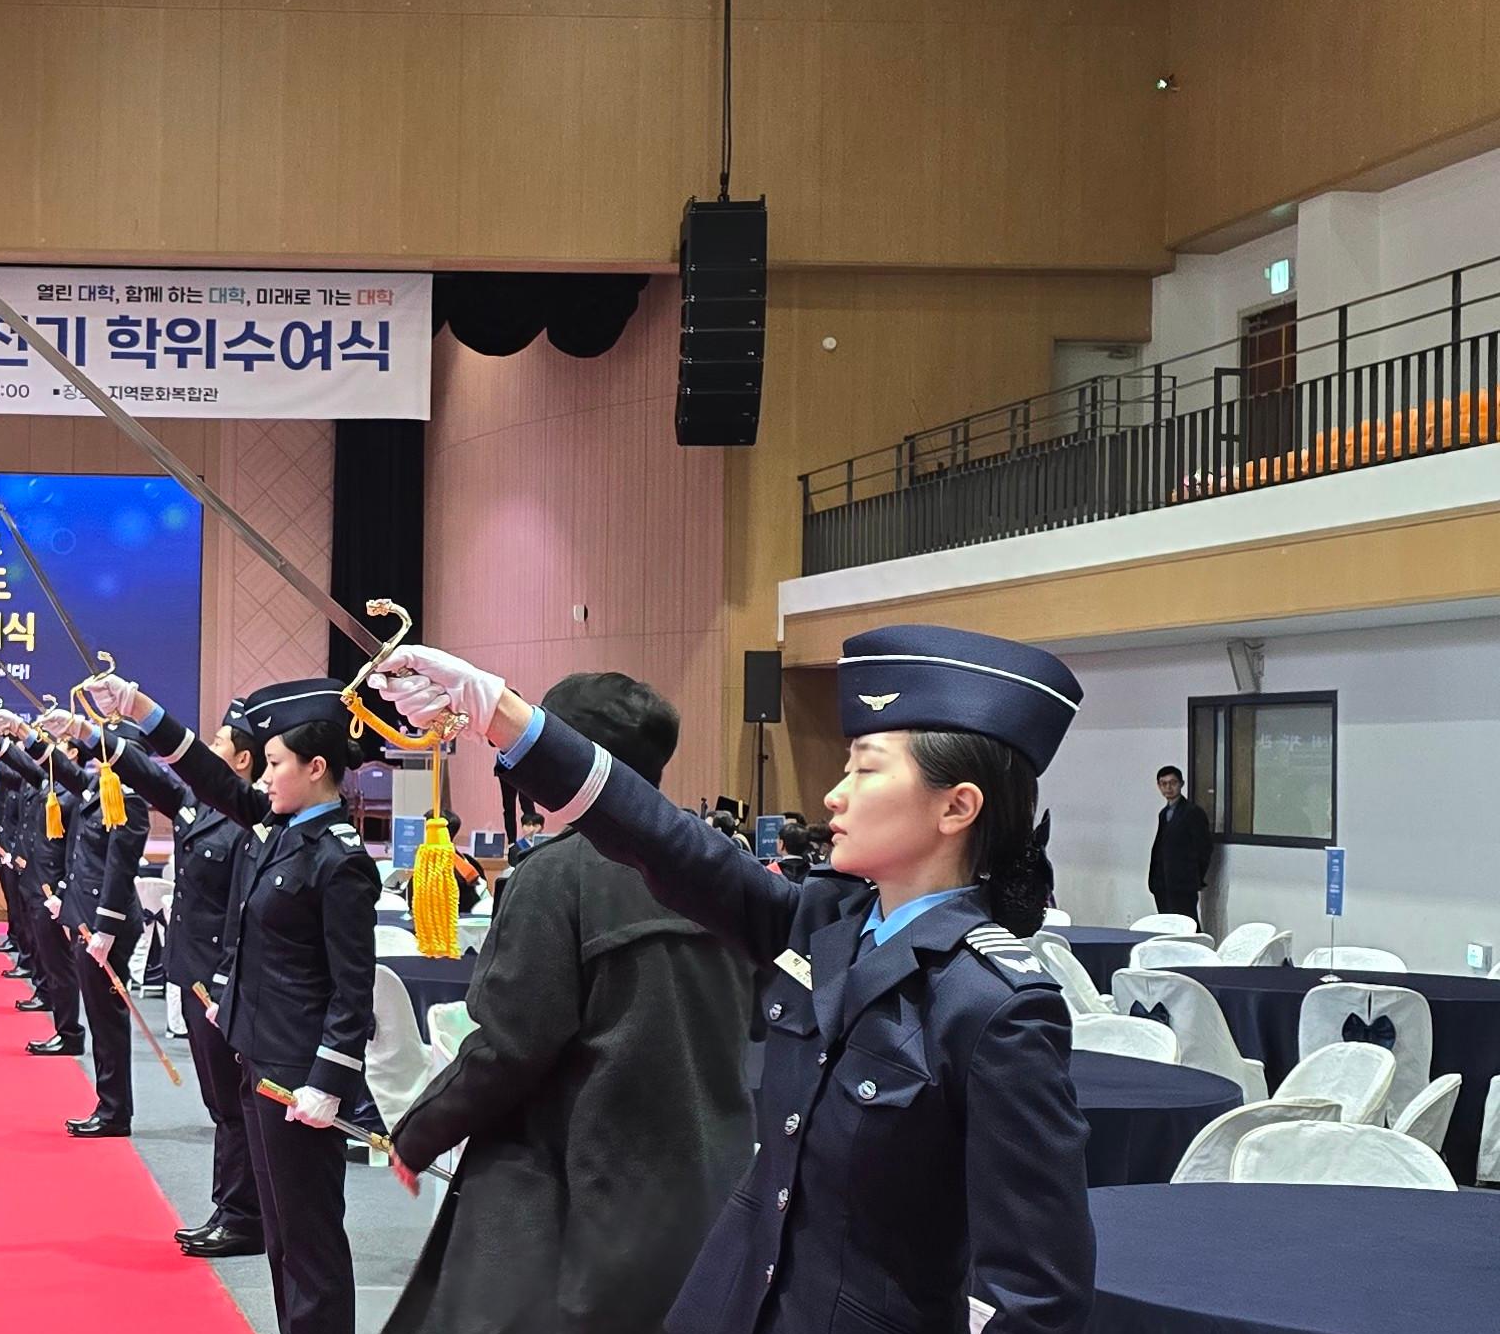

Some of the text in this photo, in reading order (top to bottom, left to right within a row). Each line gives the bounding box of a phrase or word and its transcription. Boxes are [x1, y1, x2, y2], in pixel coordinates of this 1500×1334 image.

[37, 284, 394, 307] 열린 대학, 함께 하는 대학, 미래로 가는 대학
[106, 314, 390, 372] 학위수여식
[108, 385, 218, 403] 지역문화복합관
